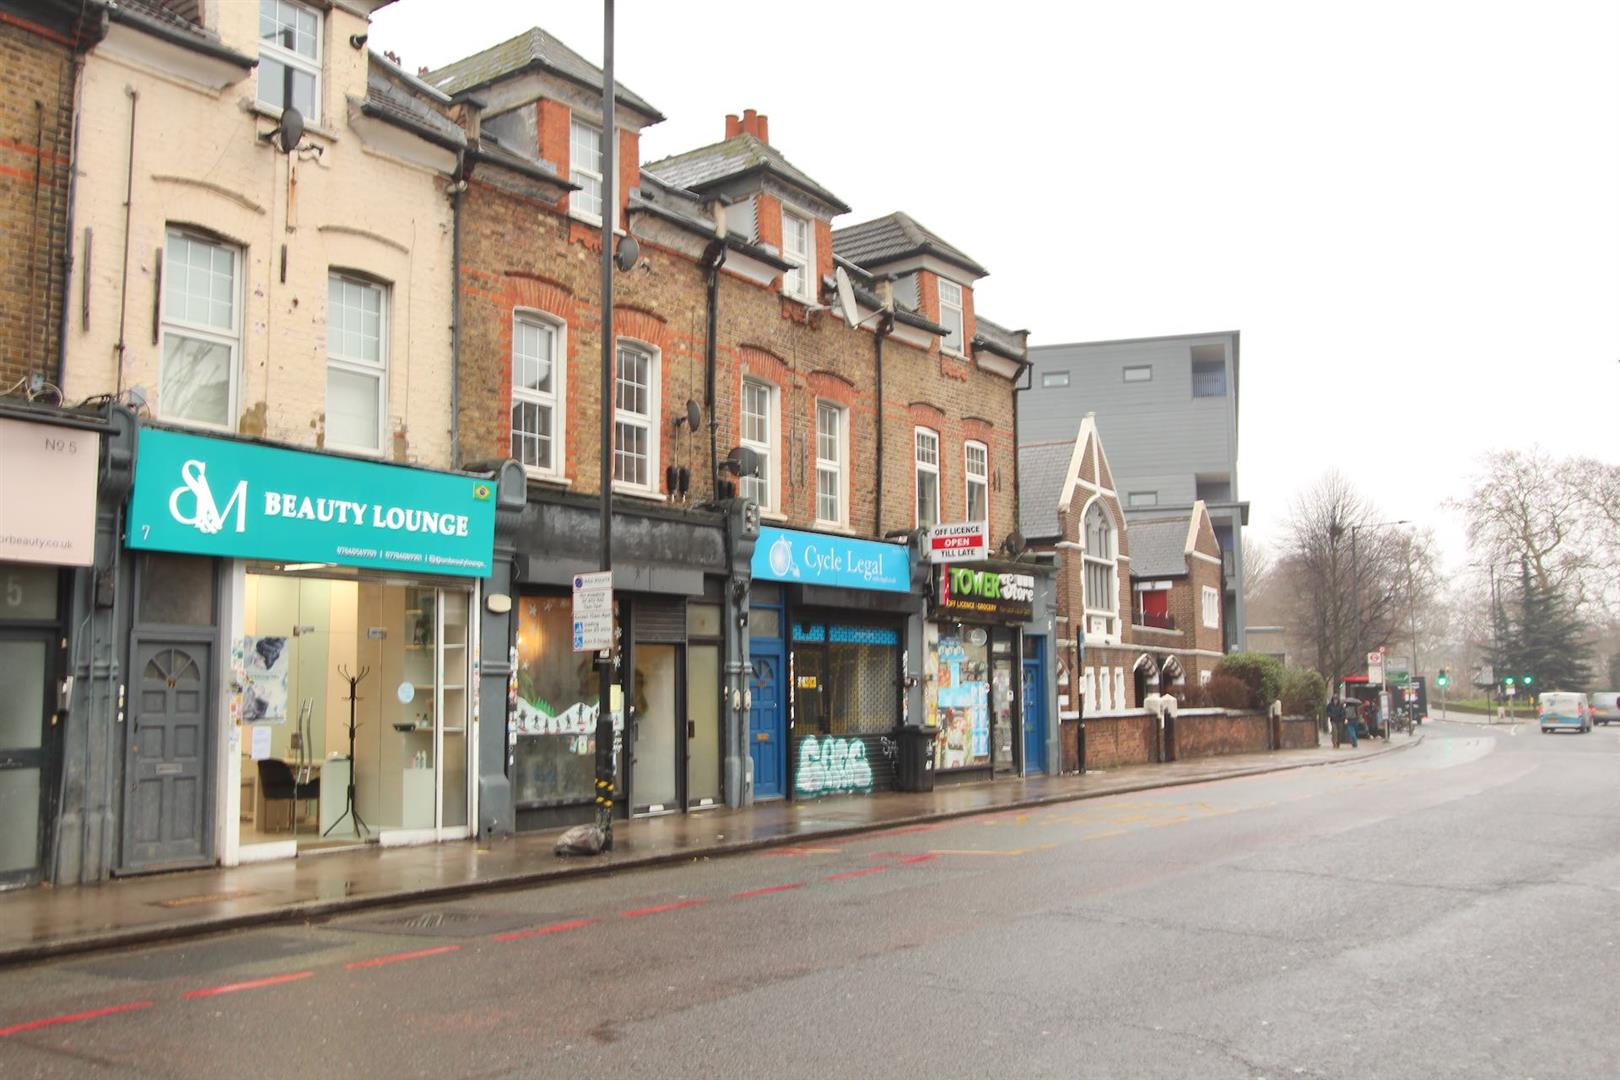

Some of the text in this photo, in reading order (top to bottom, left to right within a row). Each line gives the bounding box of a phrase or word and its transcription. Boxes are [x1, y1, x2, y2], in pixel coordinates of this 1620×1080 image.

[69, 441, 77, 454] 5
[264, 491, 469, 537] BEAUTY LOUNGE
[142, 524, 151, 540] 7
[934, 525, 980, 536] OFF LICENCE
[944, 538, 970, 547] OPEN
[941, 548, 975, 558] TILL LATE
[804, 544, 883, 582] Cycle Legal
[6, 575, 23, 607] 5
[951, 568, 1001, 599] TOWER
[1001, 582, 1034, 603] Store
